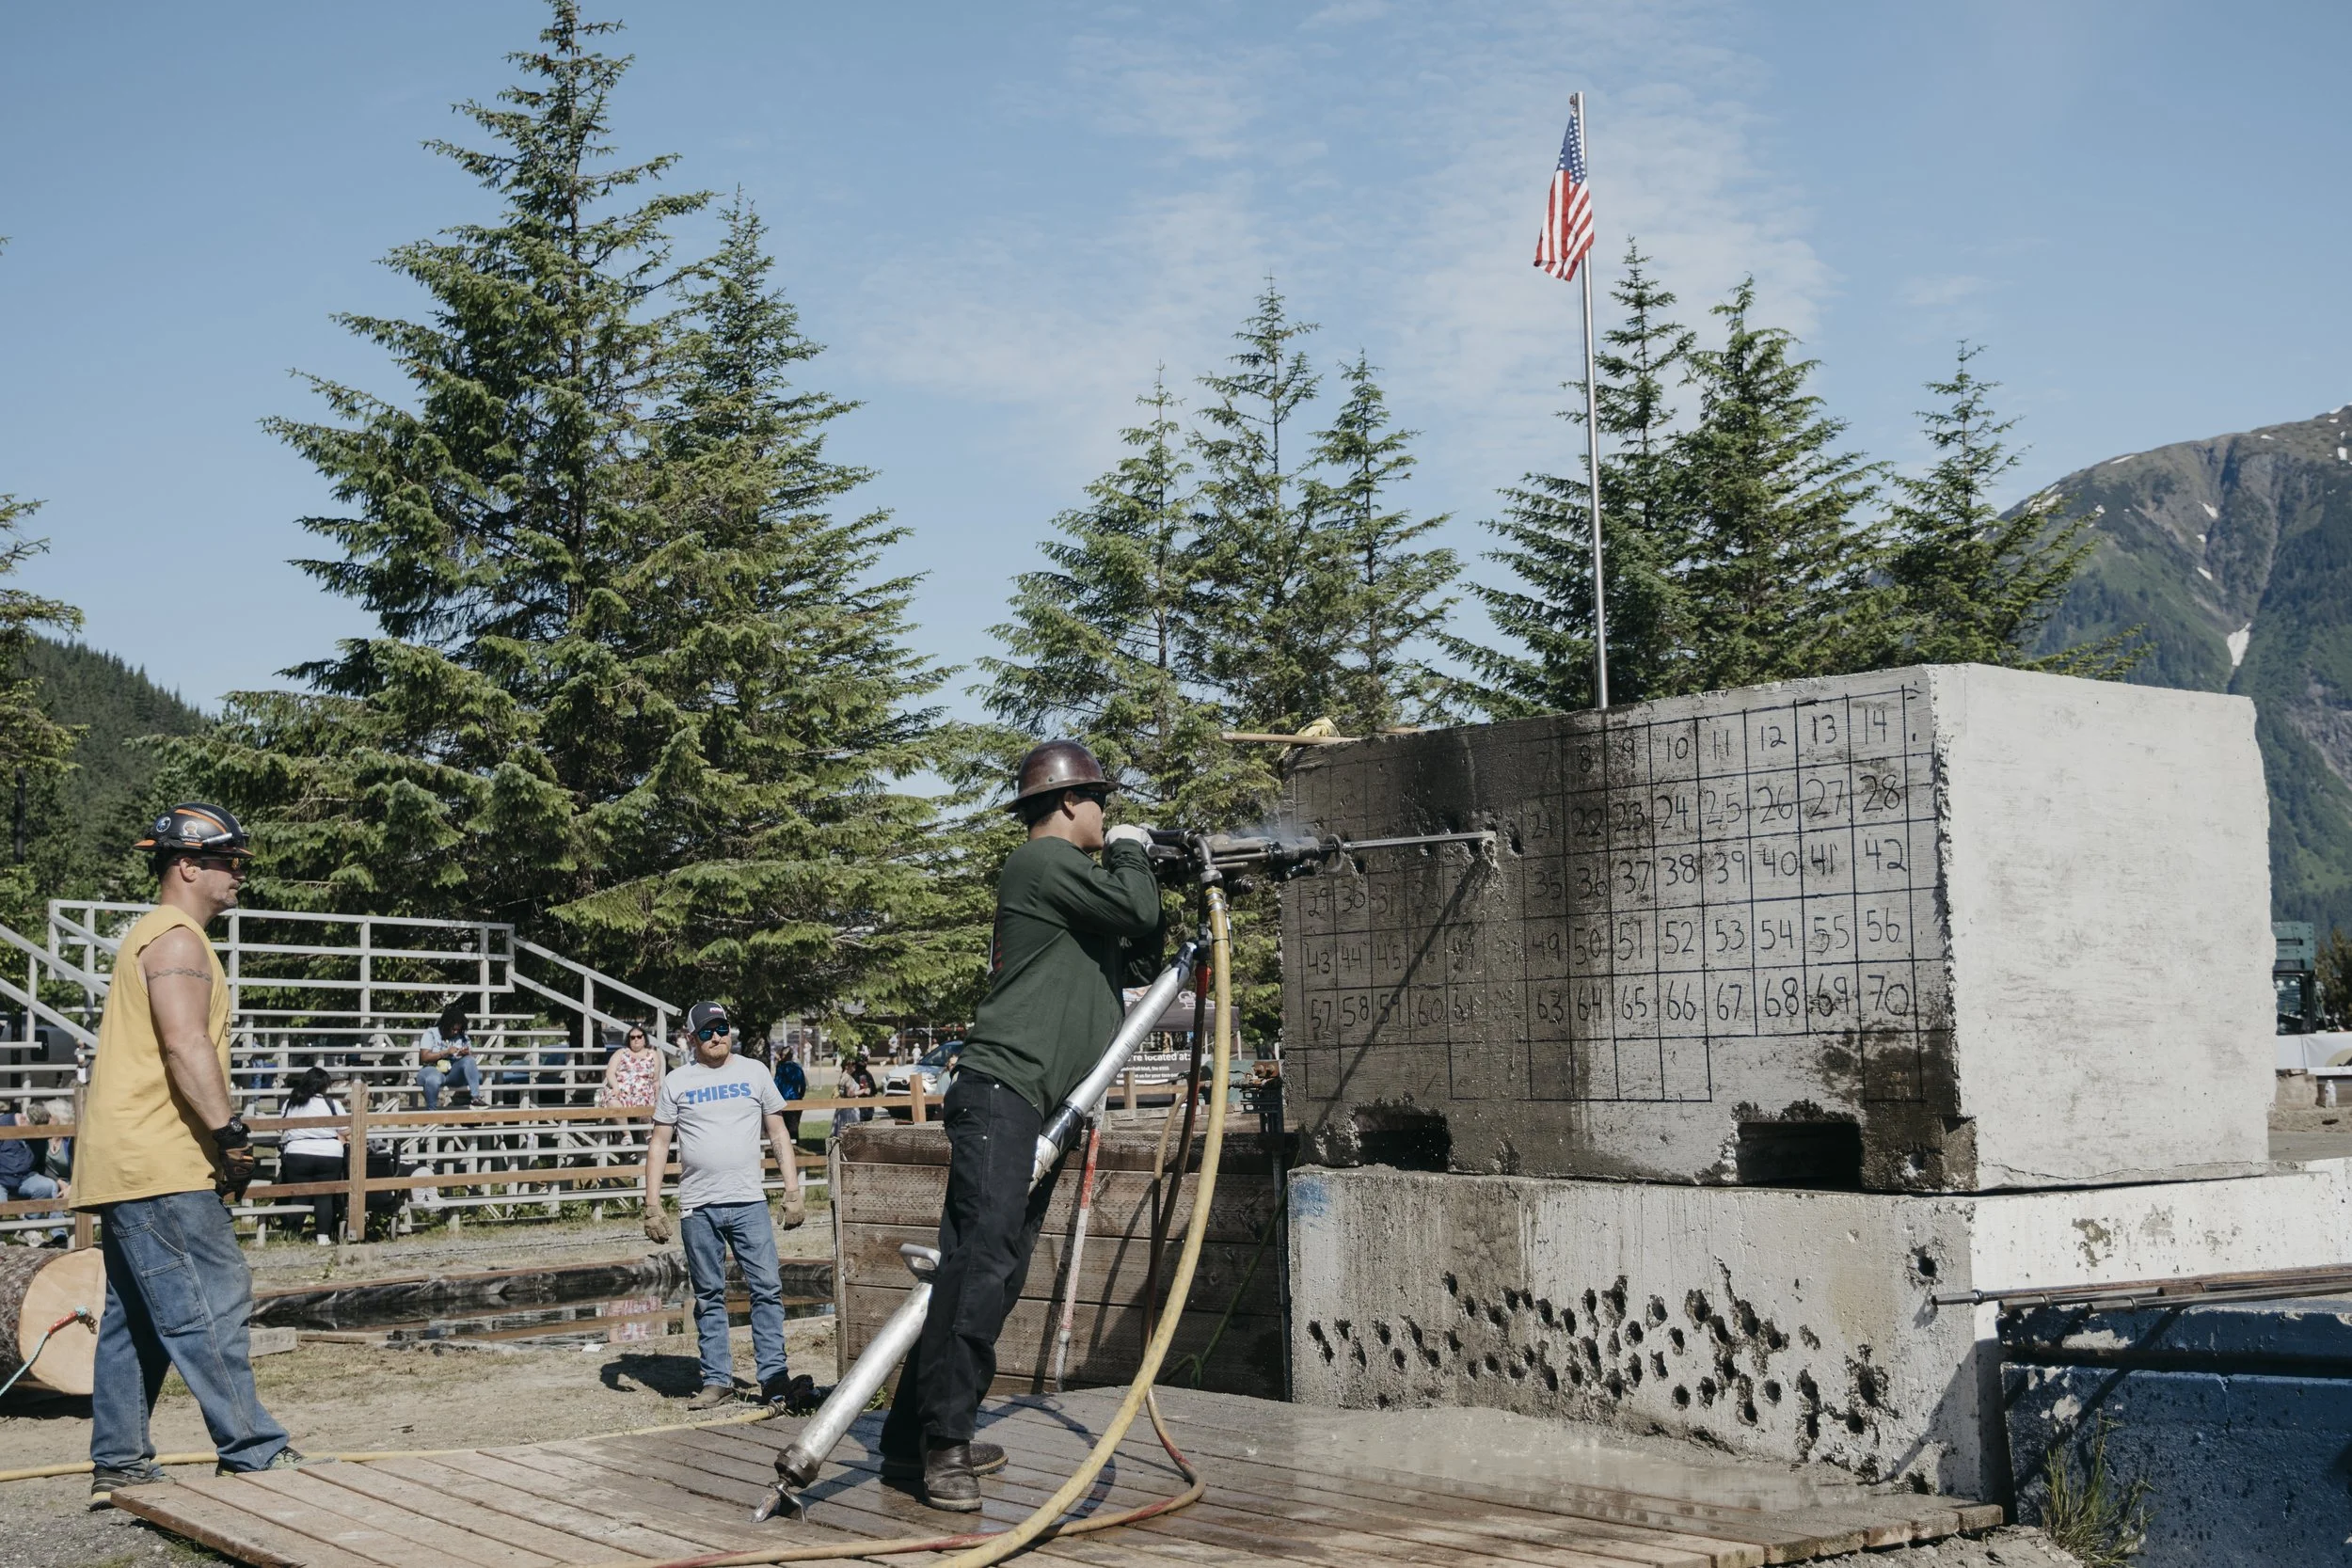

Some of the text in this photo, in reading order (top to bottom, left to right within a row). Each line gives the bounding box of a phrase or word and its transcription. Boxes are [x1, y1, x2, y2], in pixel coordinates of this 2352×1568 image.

[1581, 745, 1591, 773] 8
[1622, 737, 1636, 768] 9
[1667, 736, 1689, 763] 10
[1713, 731, 1729, 760] 11
[1761, 726, 1787, 752] 12
[1813, 715, 1836, 745] 13
[1866, 708, 1887, 745] 14
[1530, 774, 1900, 839] 21 22 23 24 25 26 27 28
[1309, 888, 1329, 917] 29
[1343, 886, 1365, 912] 30
[1376, 884, 1394, 916] 31
[1533, 870, 1563, 899] 35
[1577, 866, 1607, 899] 36
[1619, 861, 1651, 895] 37
[1661, 853, 1695, 886] 38
[1714, 850, 1746, 884] 39
[1762, 847, 1798, 878] 40
[1811, 844, 1836, 875] 41
[1865, 839, 1907, 872] 42
[1307, 942, 1331, 974] 43
[1342, 944, 1362, 973] 44
[1377, 943, 1402, 970] 45
[1533, 932, 1560, 961] 49
[1575, 927, 1601, 965] 50
[1617, 921, 1643, 960] 51
[1664, 921, 1694, 954] 52
[1715, 919, 1744, 952] 53
[1761, 919, 1793, 950] 54
[1808, 915, 1850, 954] 55
[1867, 908, 1900, 942] 56
[1311, 999, 1331, 1031] 57
[1343, 996, 1369, 1027] 58
[1379, 994, 1402, 1024] 59
[1418, 997, 1444, 1026] 60
[1454, 994, 1473, 1022] 61
[1537, 990, 1564, 1024] 63
[1578, 985, 1602, 1022] 64
[1621, 985, 1647, 1020] 65
[1667, 980, 1695, 1021] 66
[1716, 982, 1741, 1021] 67
[1764, 977, 1799, 1017] 68
[1817, 974, 1849, 1017] 69
[1867, 974, 1910, 1016] 70
[1144, 1053, 1178, 1062] located
[1179, 1053, 1191, 1062] at:
[686, 1083, 752, 1105] THIESS
